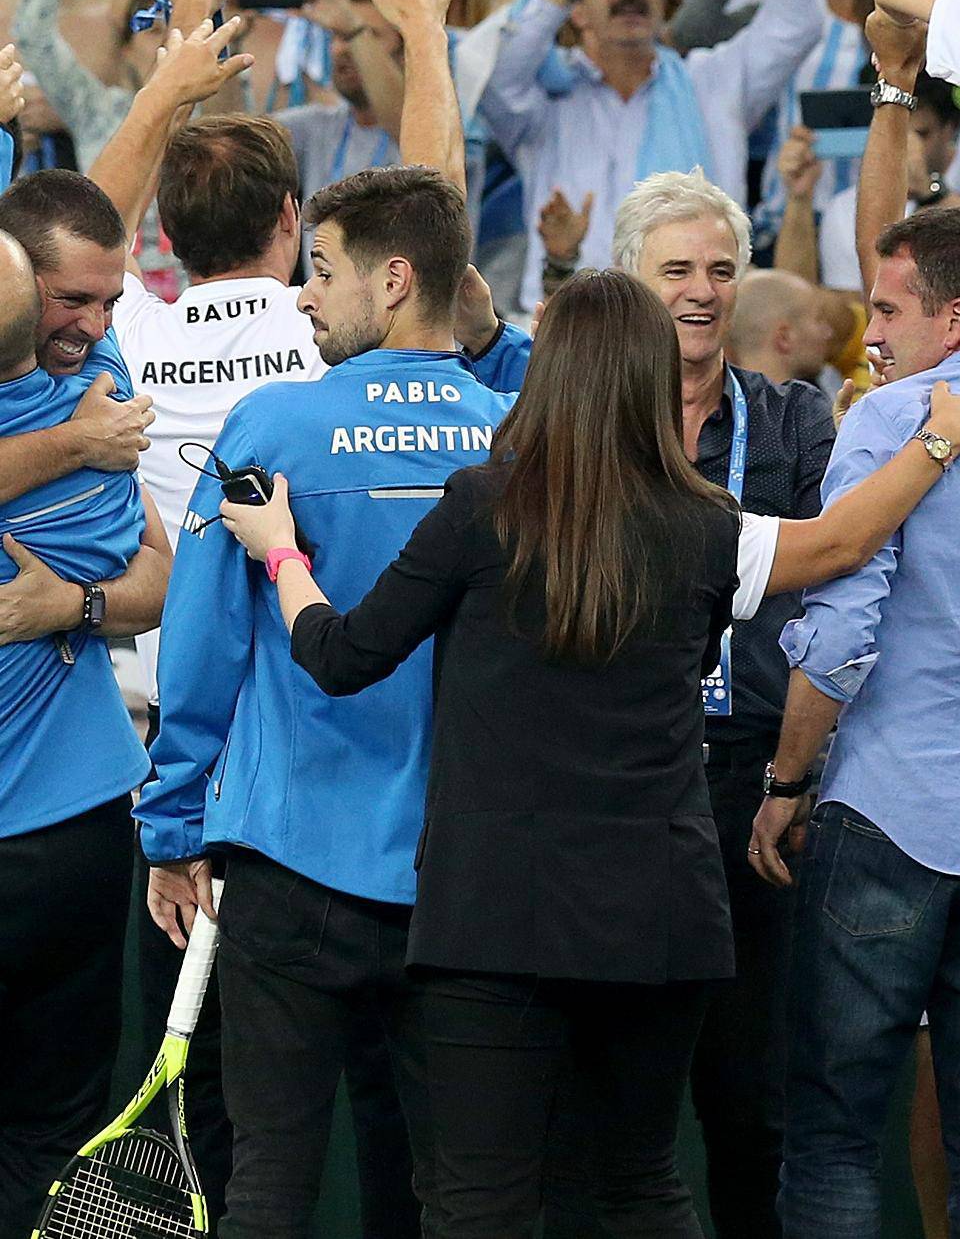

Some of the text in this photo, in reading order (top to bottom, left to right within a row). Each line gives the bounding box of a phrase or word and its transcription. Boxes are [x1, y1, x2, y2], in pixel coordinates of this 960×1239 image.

[186, 297, 267, 324] BAUTI
[141, 348, 306, 385] ARGENTINA
[365, 380, 462, 404] PABLO
